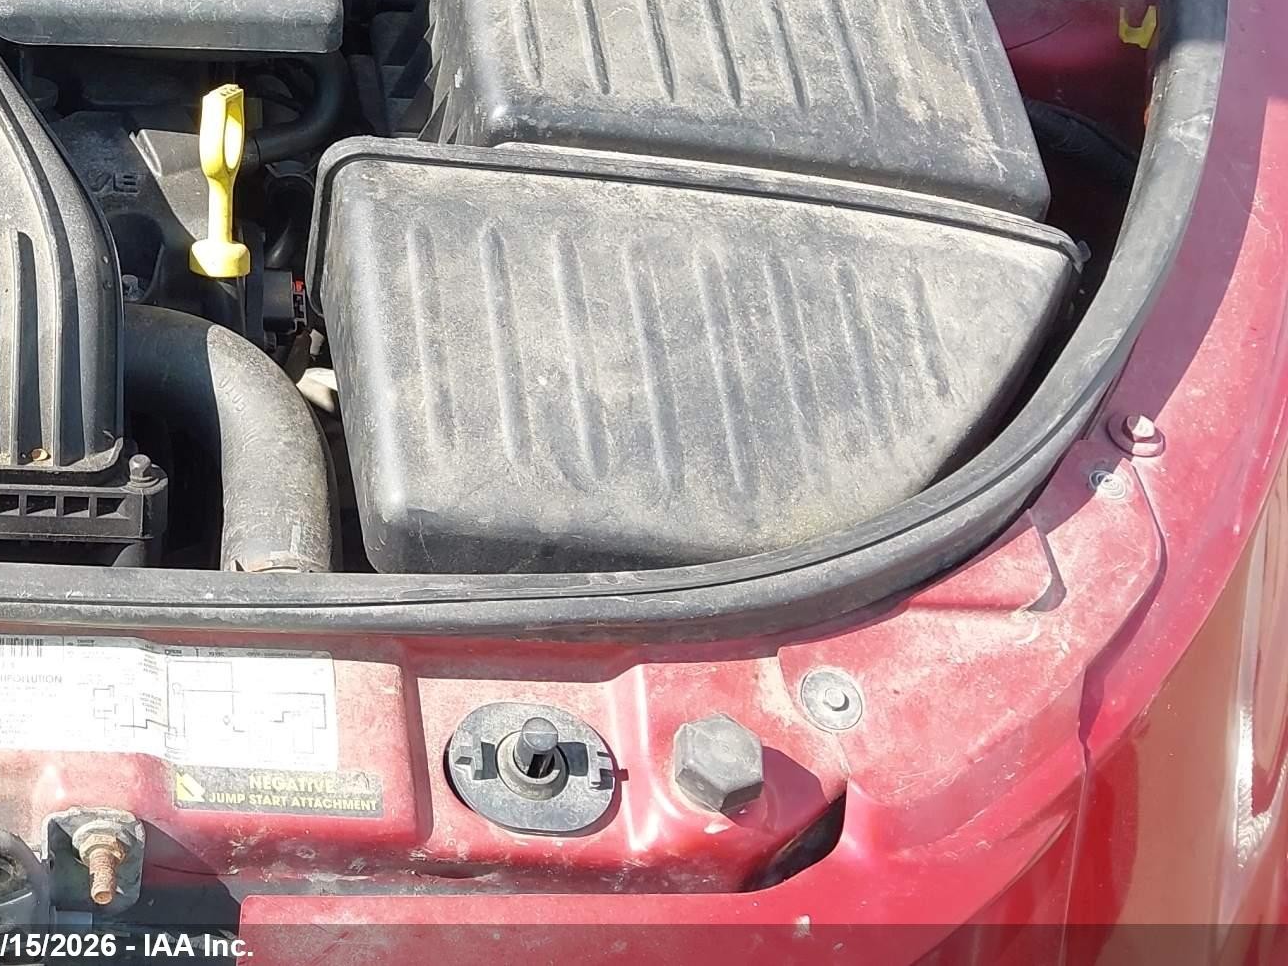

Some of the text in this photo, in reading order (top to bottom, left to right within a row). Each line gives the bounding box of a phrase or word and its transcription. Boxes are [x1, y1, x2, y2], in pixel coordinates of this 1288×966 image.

[249, 774, 336, 794] NEGATIVE
[208, 792, 378, 812] JUMP START ATTACHMENT
